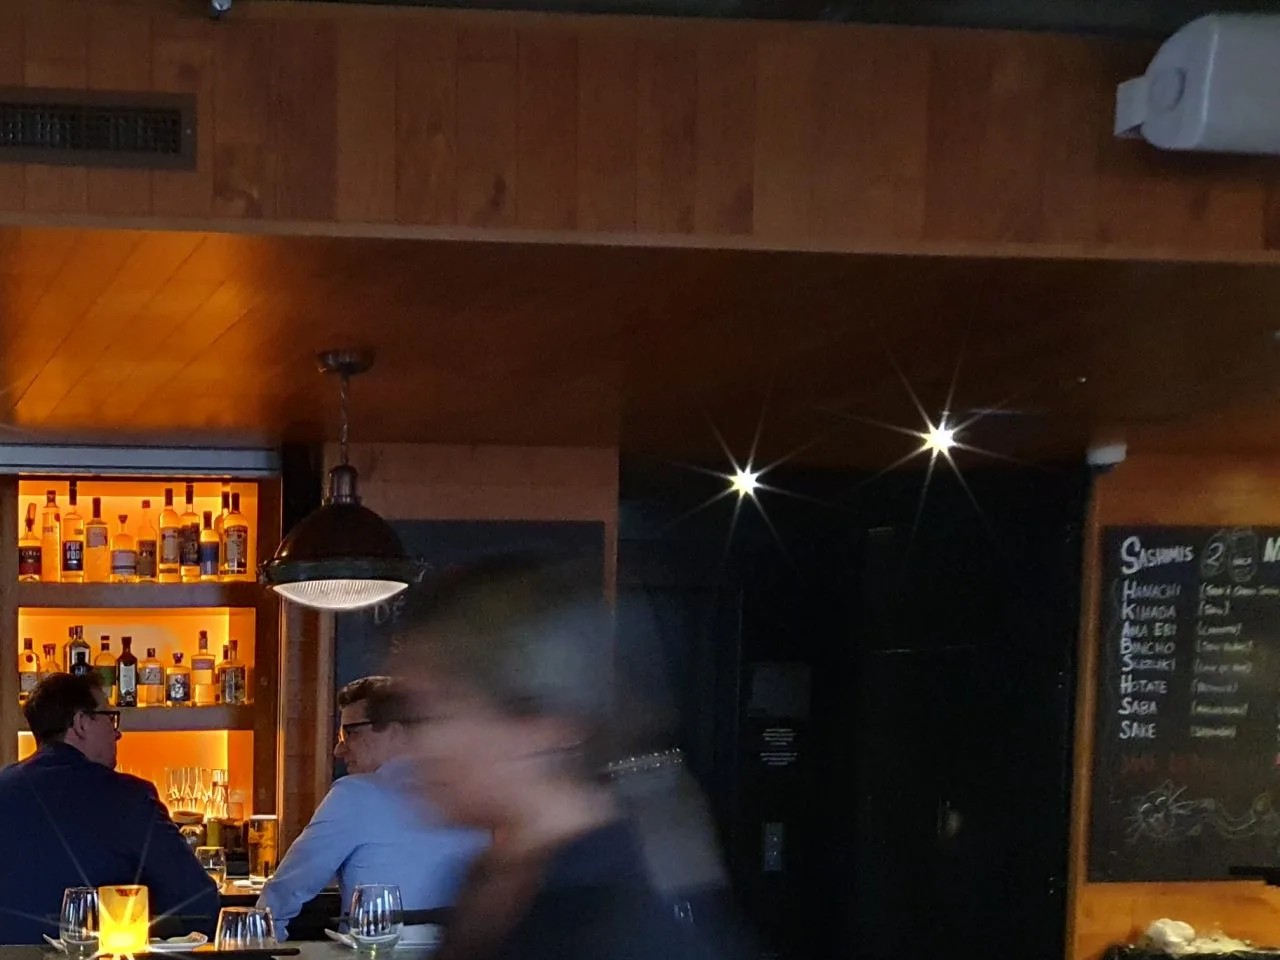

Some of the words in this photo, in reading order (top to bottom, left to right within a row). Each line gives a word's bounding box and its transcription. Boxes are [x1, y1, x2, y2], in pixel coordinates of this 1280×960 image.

[1120, 674, 1168, 694] HOTATE
[1118, 697, 1157, 714] SABA
[1119, 720, 1157, 739] SAKE
